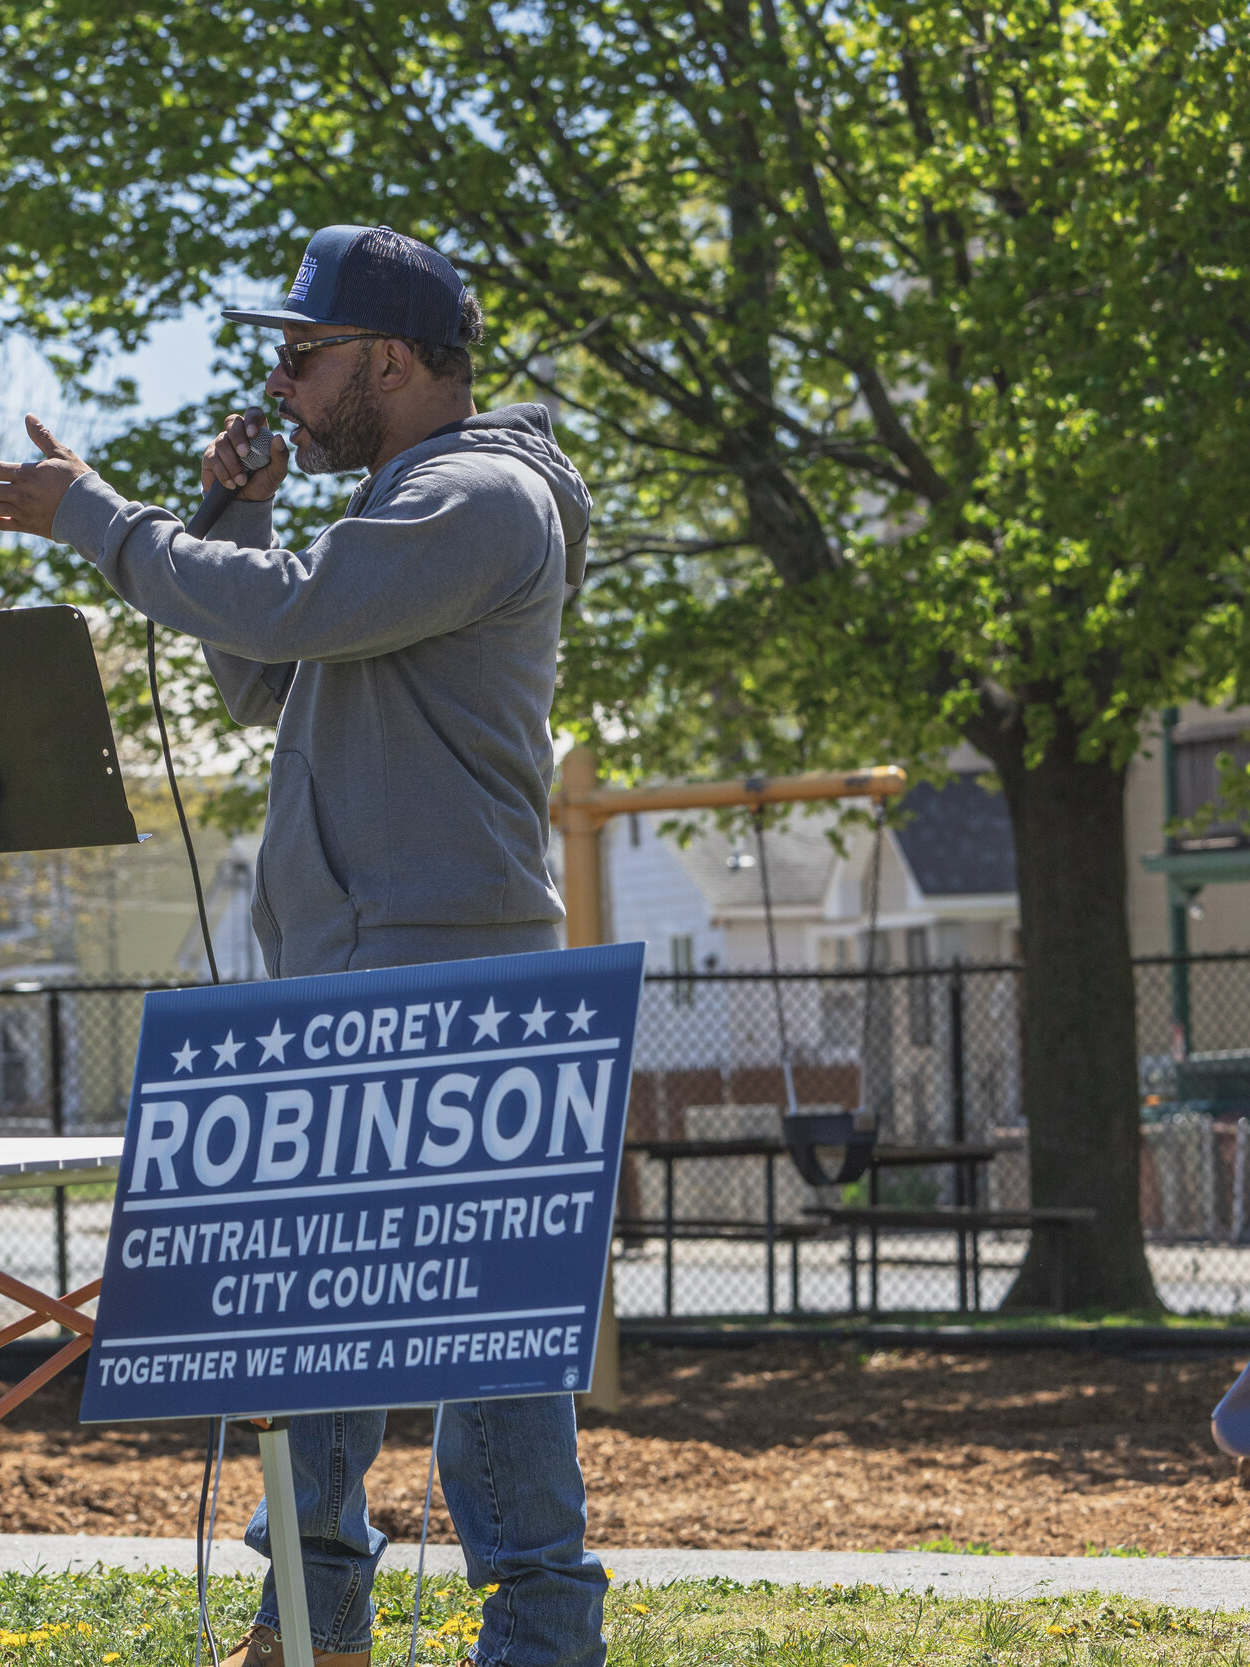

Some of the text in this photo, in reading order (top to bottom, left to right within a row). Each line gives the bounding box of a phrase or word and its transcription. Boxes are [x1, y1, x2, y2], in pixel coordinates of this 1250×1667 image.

[303, 1000, 462, 1060] COREY
[128, 1058, 616, 1193] ROBINSON
[122, 1191, 595, 1269] CENTRALVILLE DISTRICT
[212, 1257, 479, 1316] CITY COUNCIL
[99, 1325, 582, 1387] TOGETHER WE MAKE A DIFFERENCE
